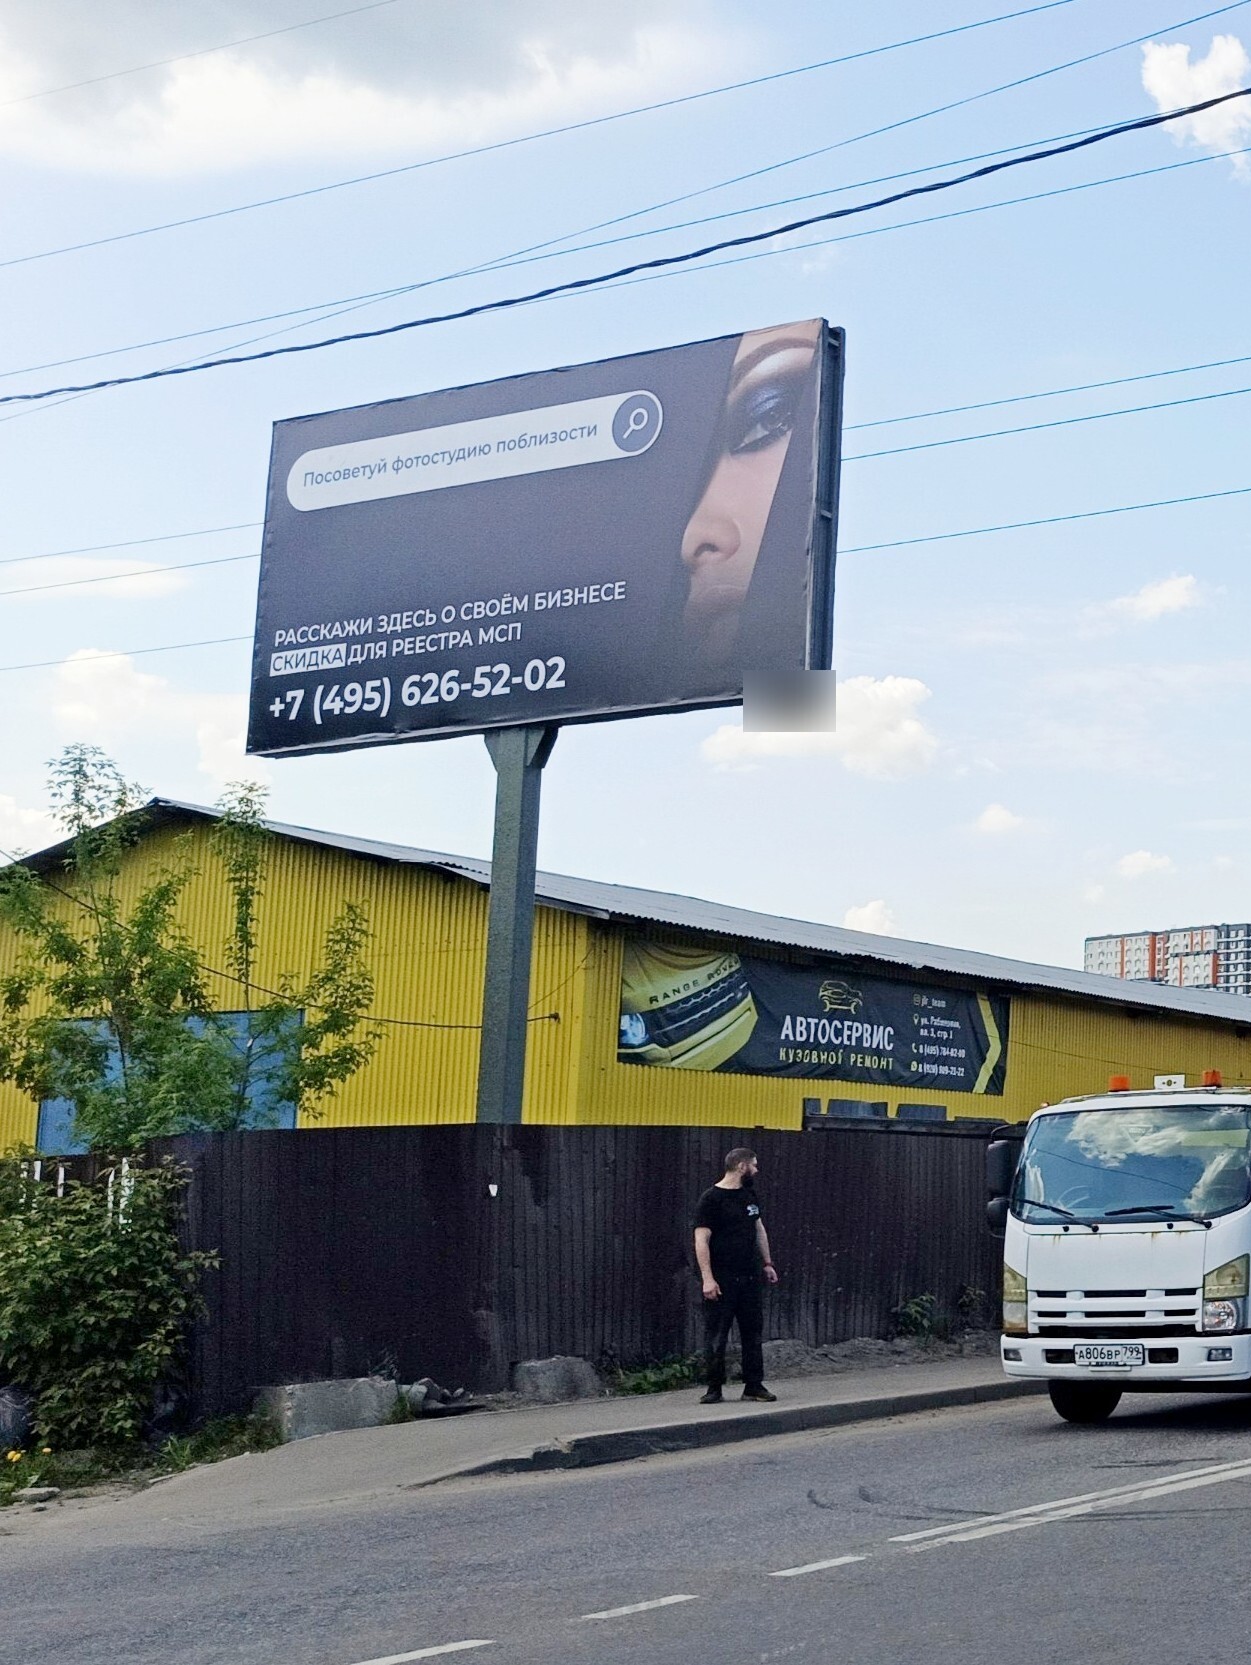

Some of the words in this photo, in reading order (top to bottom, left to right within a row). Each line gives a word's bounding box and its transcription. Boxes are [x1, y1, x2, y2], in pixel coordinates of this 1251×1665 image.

[303, 458, 387, 488] Посоветуй
[391, 442, 491, 475] фотостудию
[496, 424, 598, 454] поблизости
[274, 617, 373, 647] РАССКАЖИ
[376, 608, 437, 635] ЗДЕСЬ
[441, 605, 456, 623] О
[460, 592, 529, 621] СВОЁМ
[534, 581, 627, 611] БИЗНЕСЕ
[272, 647, 344, 672] СКИДКА
[347, 641, 387, 666] ДЛЯ
[391, 629, 474, 657] РЕЕСТРА
[478, 622, 522, 645] МСП
[269, 689, 305, 721] +7
[313, 677, 391, 725] (495)
[401, 655, 566, 707] 626-52-02
[648, 979, 700, 1005] RANGE
[780, 1014, 895, 1051] АВТОСЕРВИС
[850, 1053, 894, 1070] РЕМОНТ
[1078, 1347, 1121, 1360] А806ВР
[1121, 1346, 1140, 1357] 799
